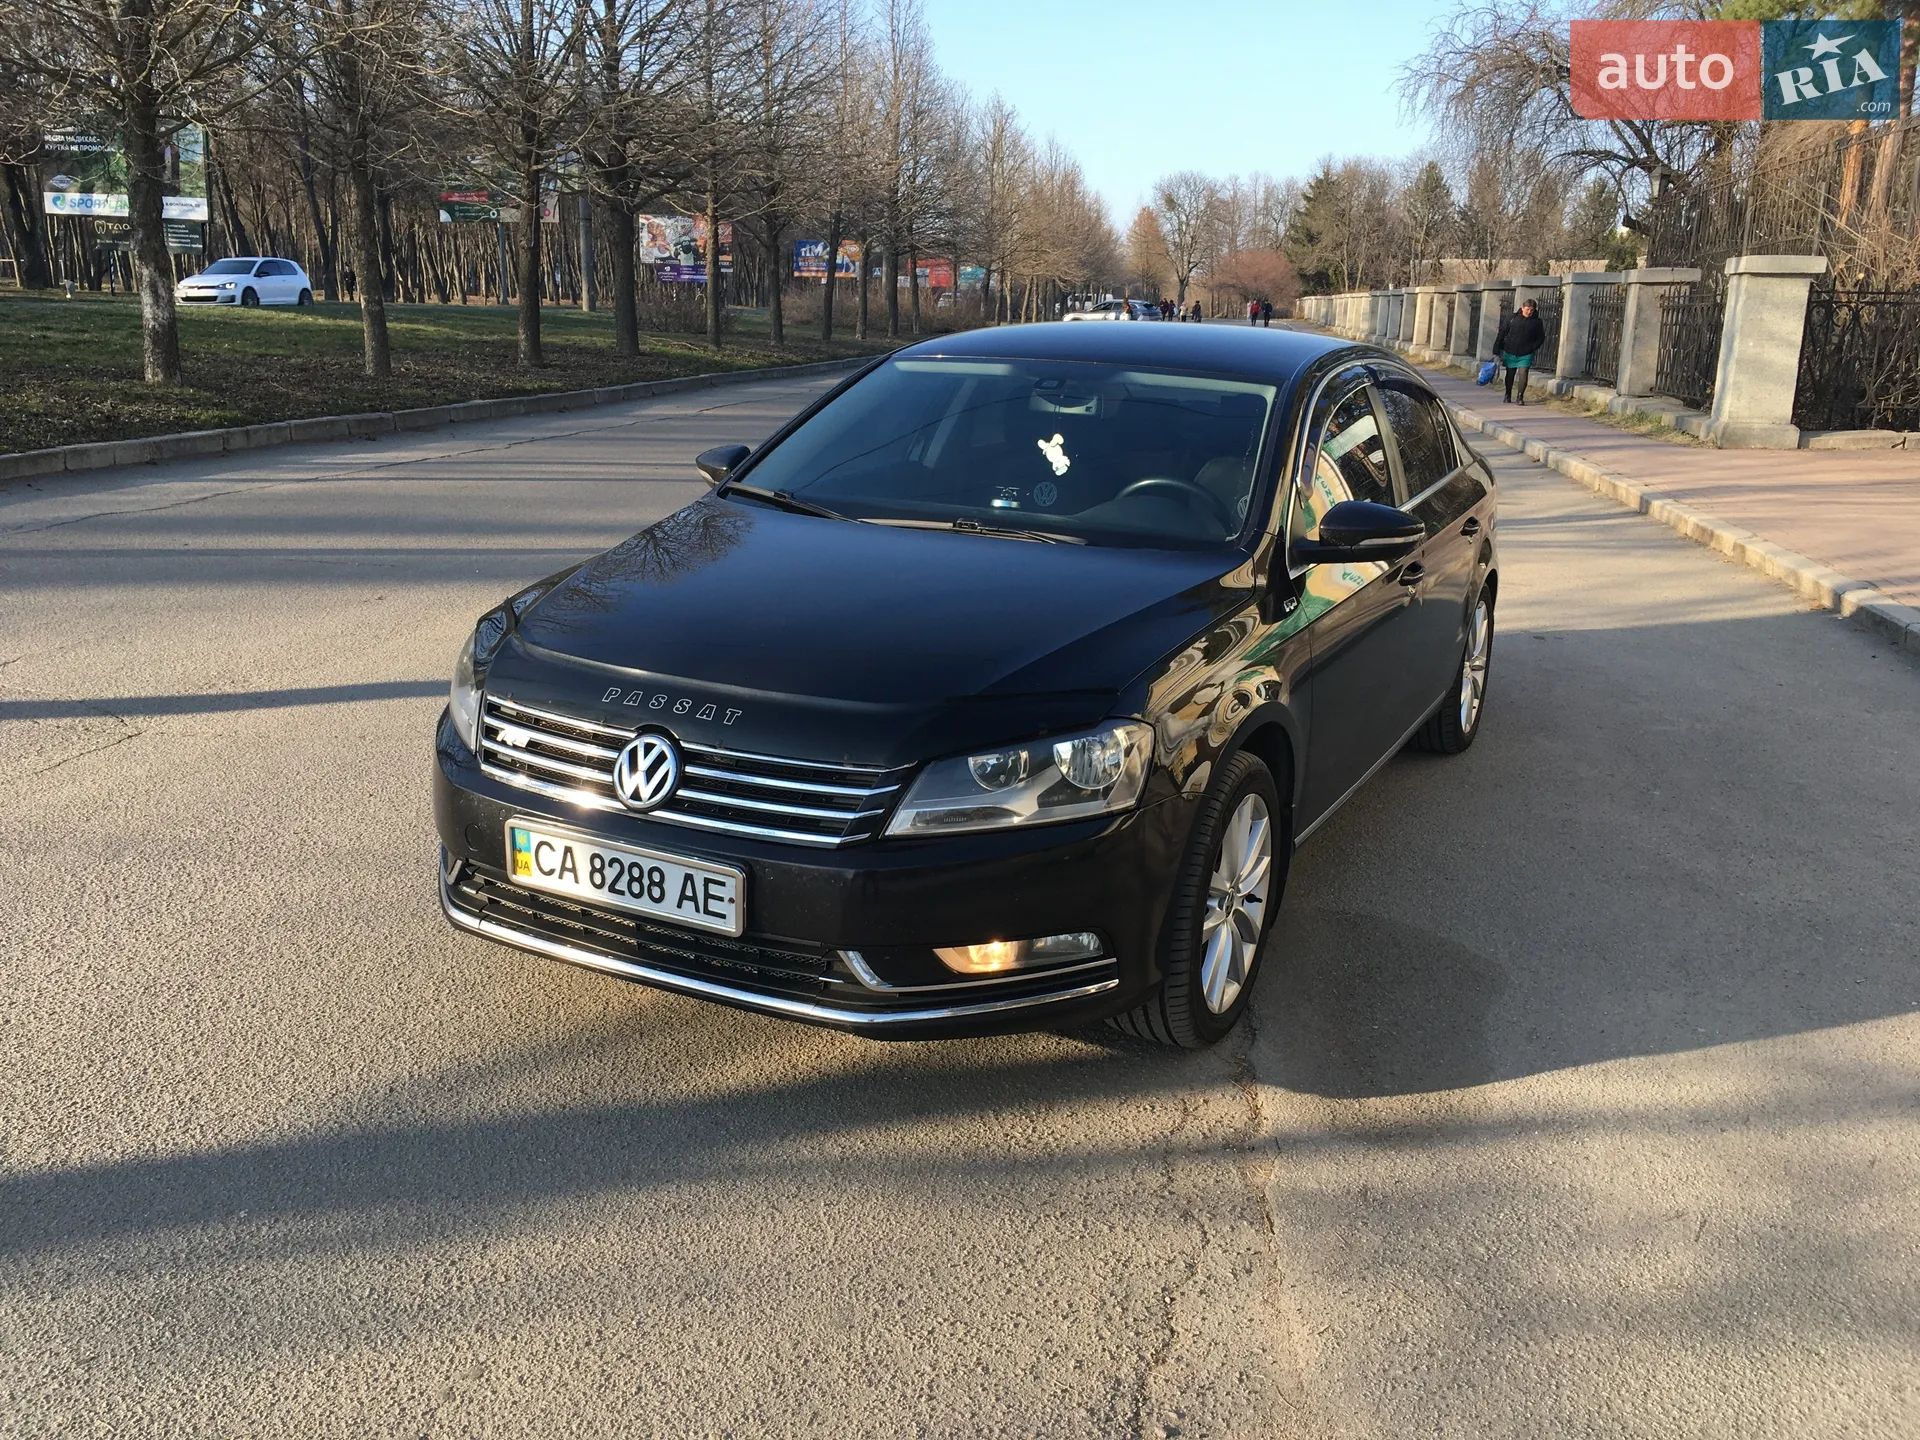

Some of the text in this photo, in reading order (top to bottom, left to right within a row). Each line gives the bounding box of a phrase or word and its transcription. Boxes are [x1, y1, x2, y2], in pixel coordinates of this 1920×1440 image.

[69, 197, 131, 210] SPORTLAN
[601, 687, 743, 725] PASSAT
[516, 859, 530, 872] UA
[534, 840, 727, 919] CA 8288 AE
